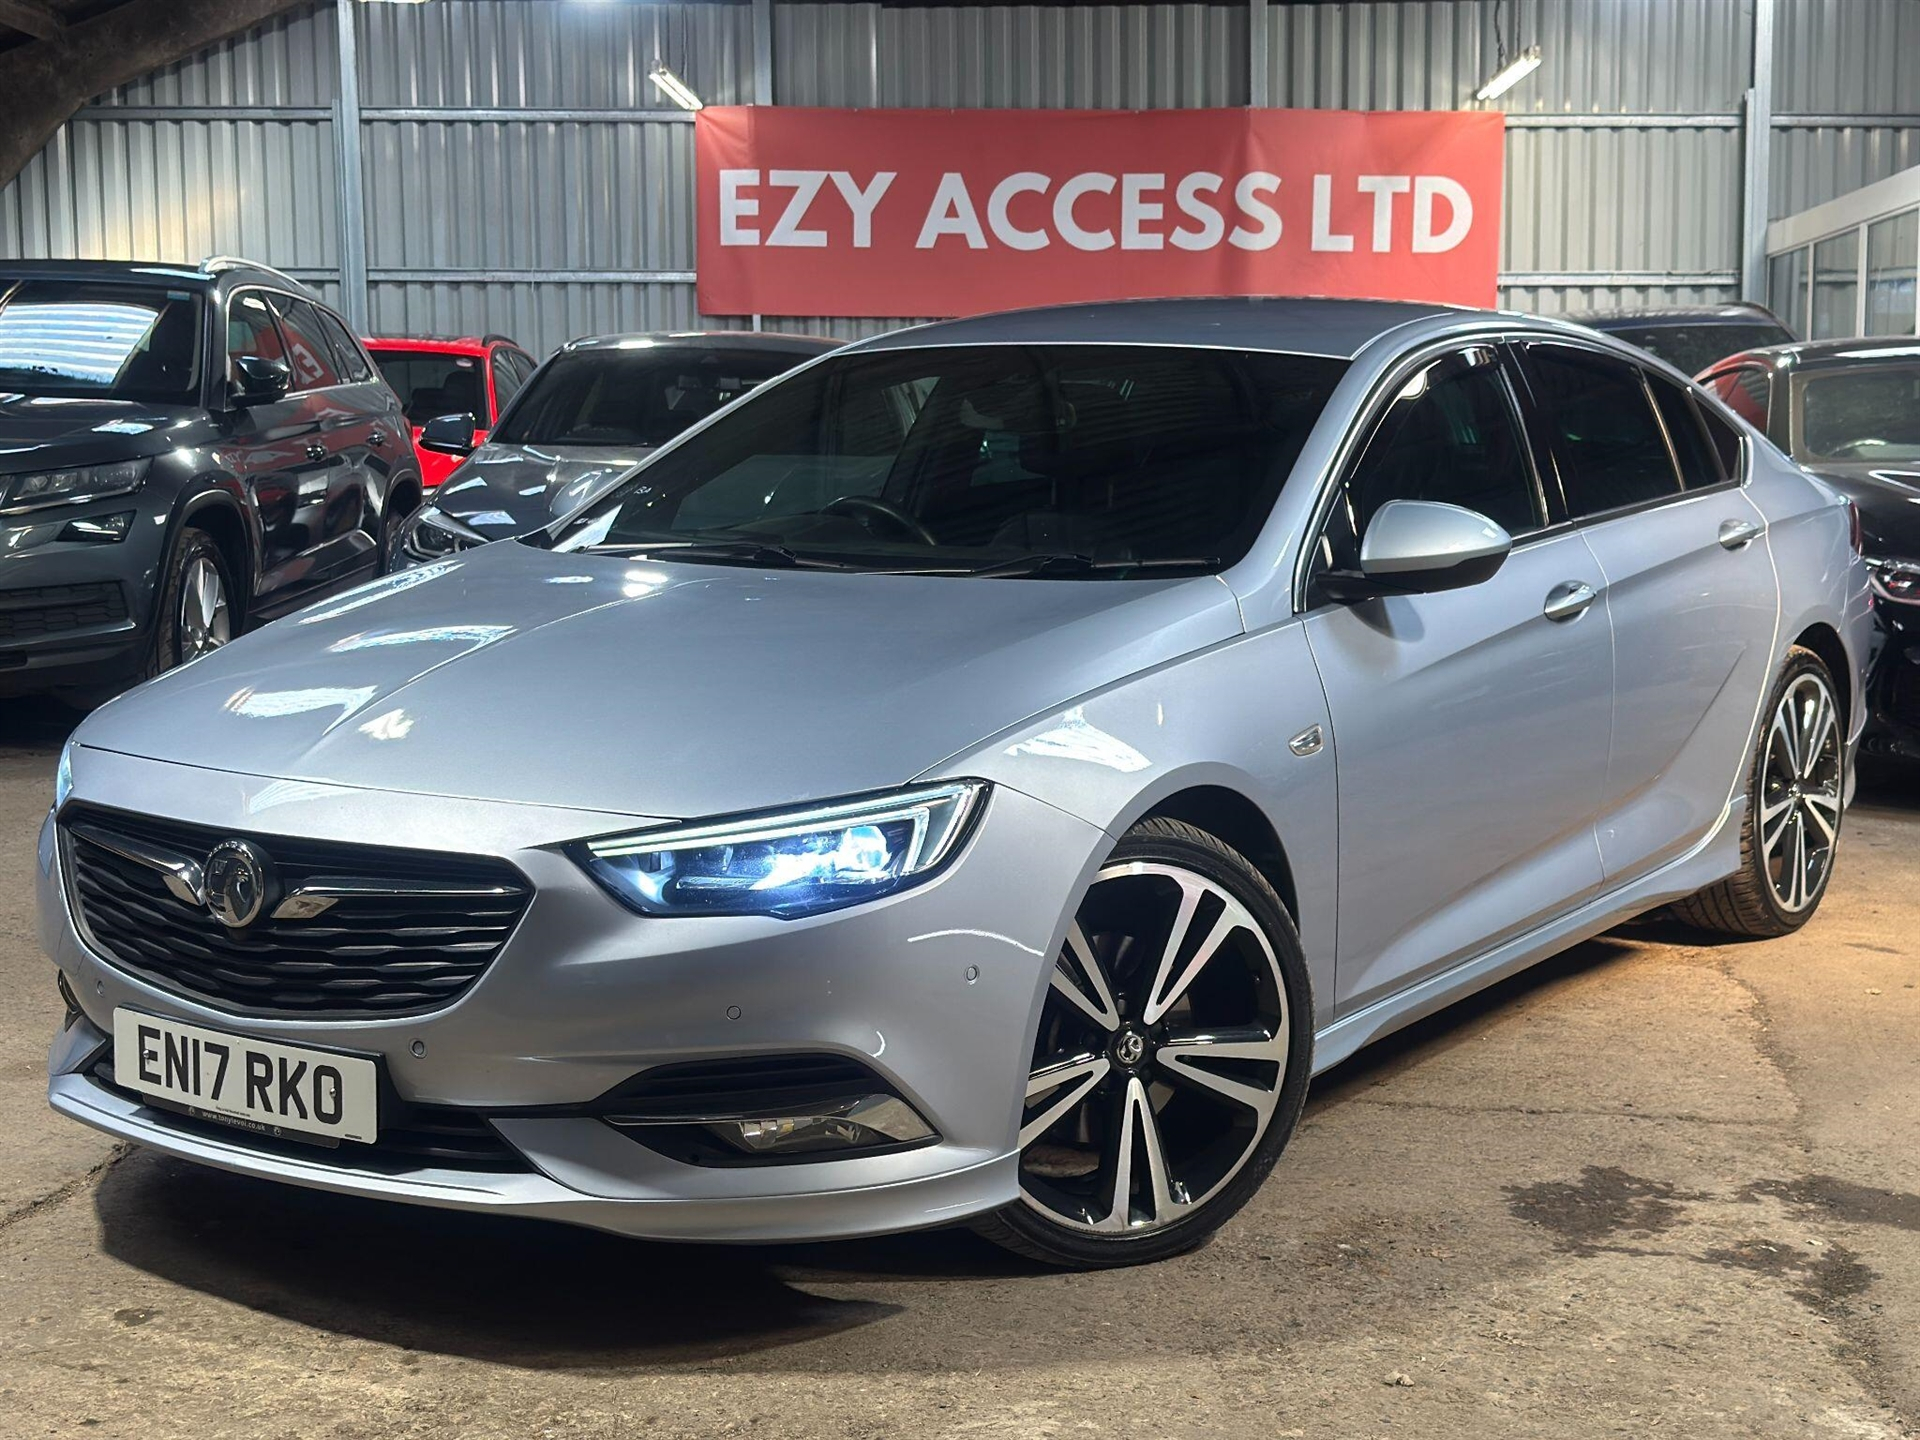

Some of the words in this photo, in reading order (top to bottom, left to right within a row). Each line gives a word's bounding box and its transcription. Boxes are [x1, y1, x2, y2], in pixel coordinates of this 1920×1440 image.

[719, 168, 897, 248] EZY
[916, 171, 1284, 252] ACCESS
[1311, 173, 1474, 254] LTD
[137, 1024, 230, 1102] EN17
[245, 1050, 343, 1125] RKO
